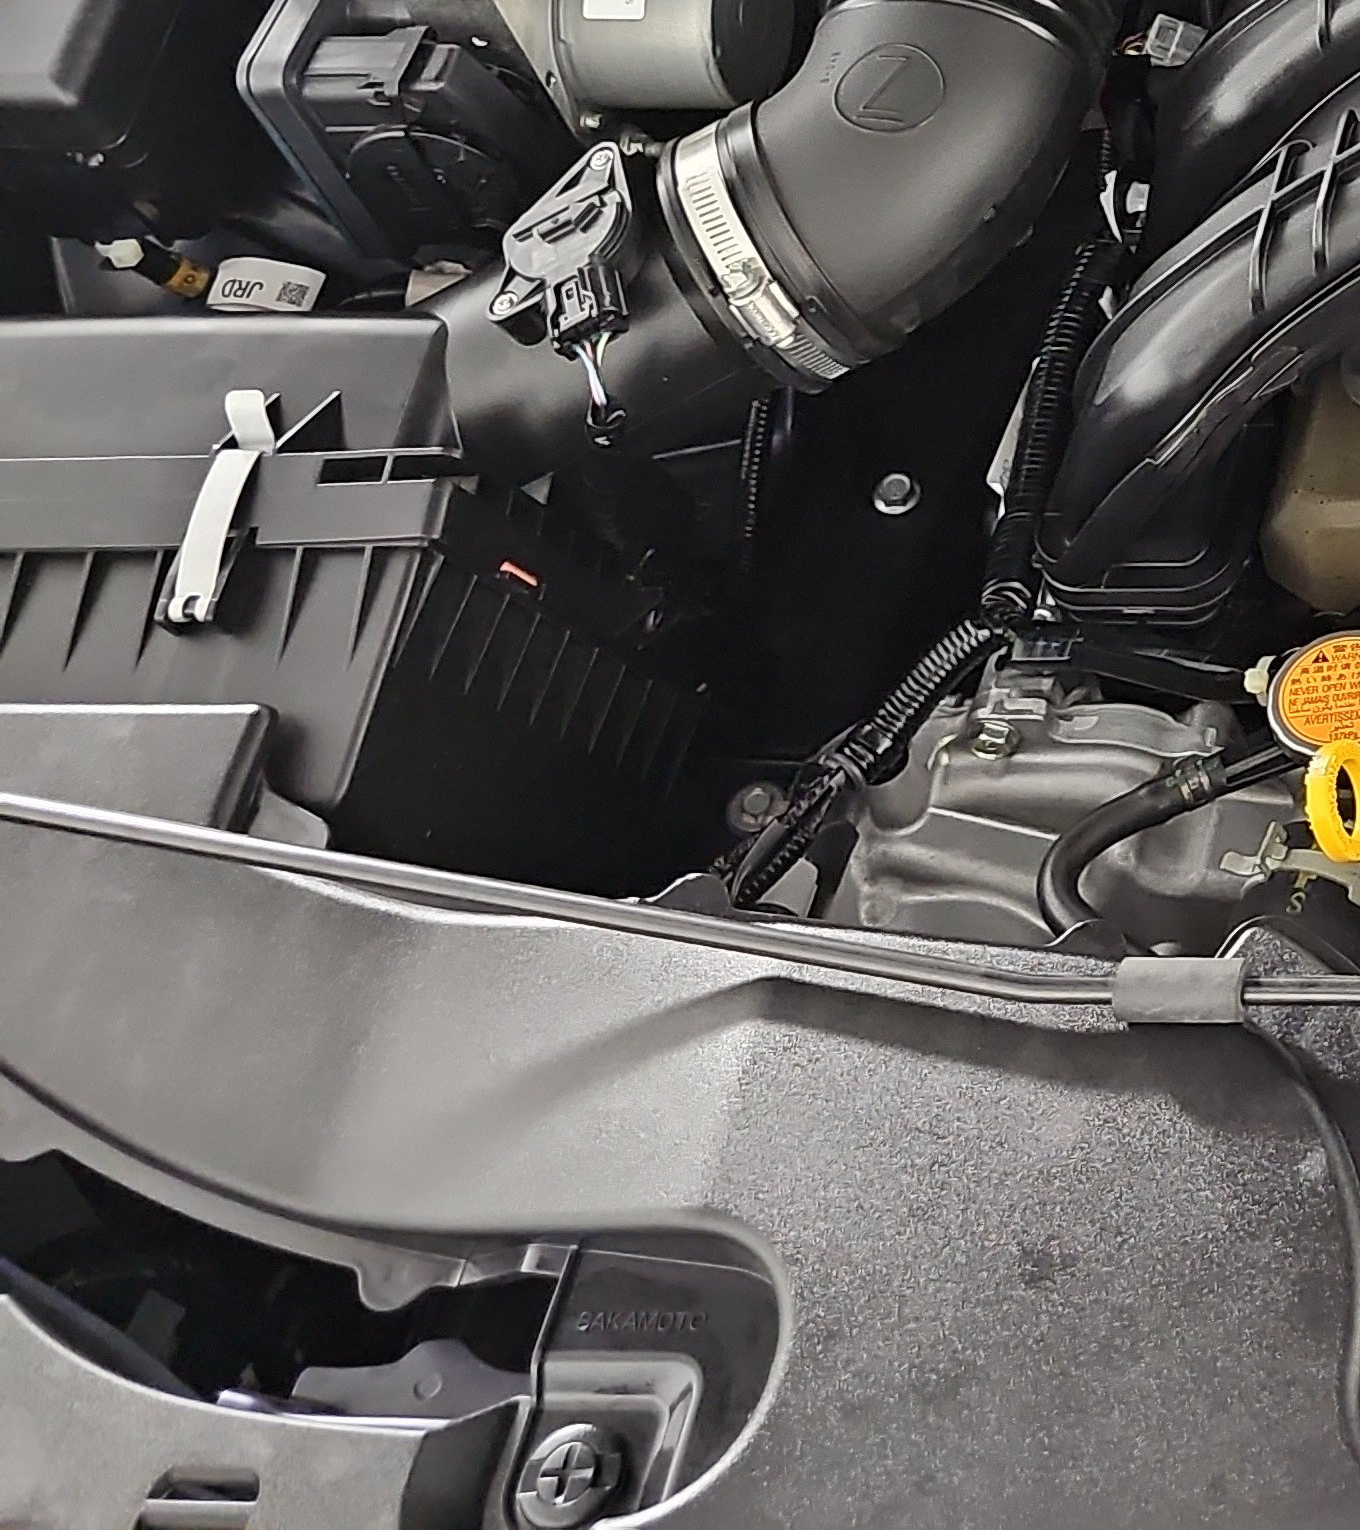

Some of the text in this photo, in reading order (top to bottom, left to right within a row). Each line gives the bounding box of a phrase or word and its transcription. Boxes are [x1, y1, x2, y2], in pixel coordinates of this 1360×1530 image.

[221, 278, 264, 299] JRD
[1289, 685, 1319, 696] NEVER
[1322, 682, 1346, 693] OPEN
[1289, 698, 1299, 707] NE
[1303, 694, 1330, 706] JAMAIS
[1332, 691, 1360, 702] OUVRIR
